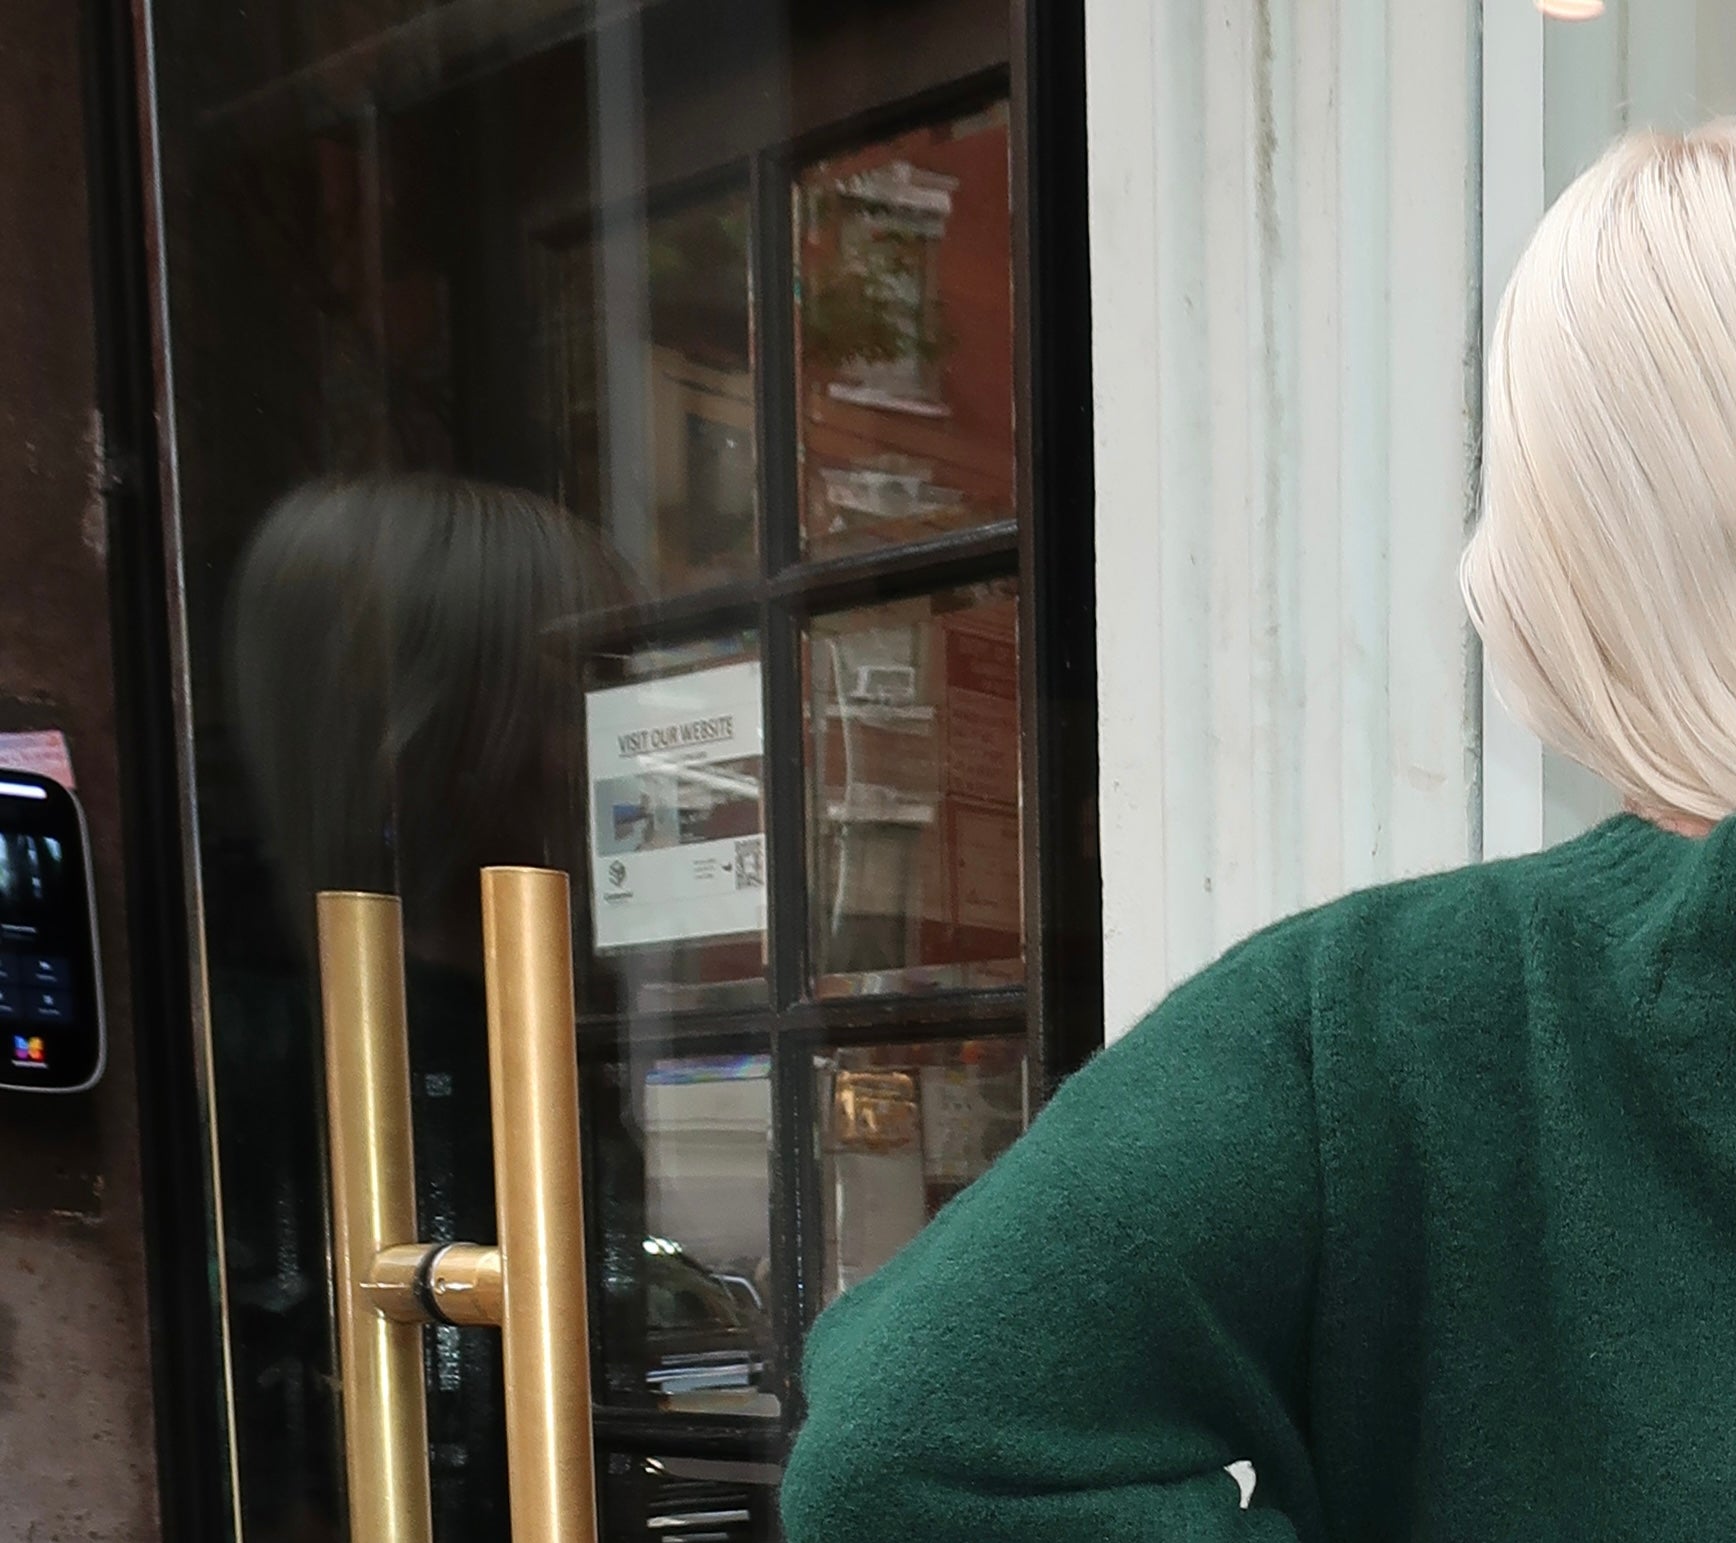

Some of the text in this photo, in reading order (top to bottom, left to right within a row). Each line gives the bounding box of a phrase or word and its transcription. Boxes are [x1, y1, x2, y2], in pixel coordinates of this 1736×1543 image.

[617, 715, 733, 753] VISIT OUR WEBSITE
